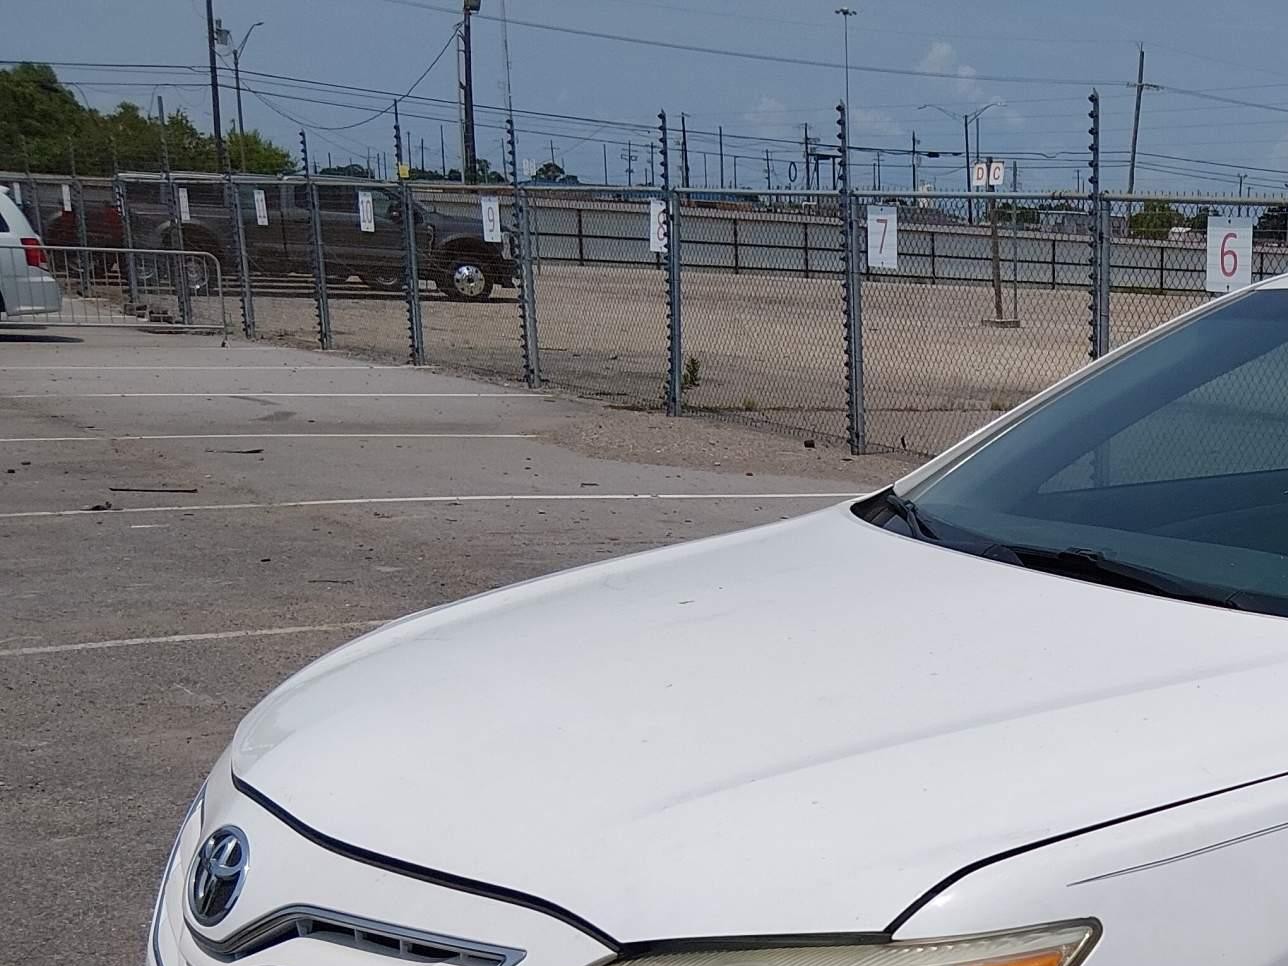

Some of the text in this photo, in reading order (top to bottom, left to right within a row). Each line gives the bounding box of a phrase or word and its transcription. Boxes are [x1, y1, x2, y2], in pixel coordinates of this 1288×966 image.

[975, 166, 1001, 181] D C
[361, 201, 373, 224] 10
[487, 206, 495, 233] 9
[657, 210, 668, 241] 8
[876, 218, 888, 254] 7
[1221, 232, 1238, 277] 6
